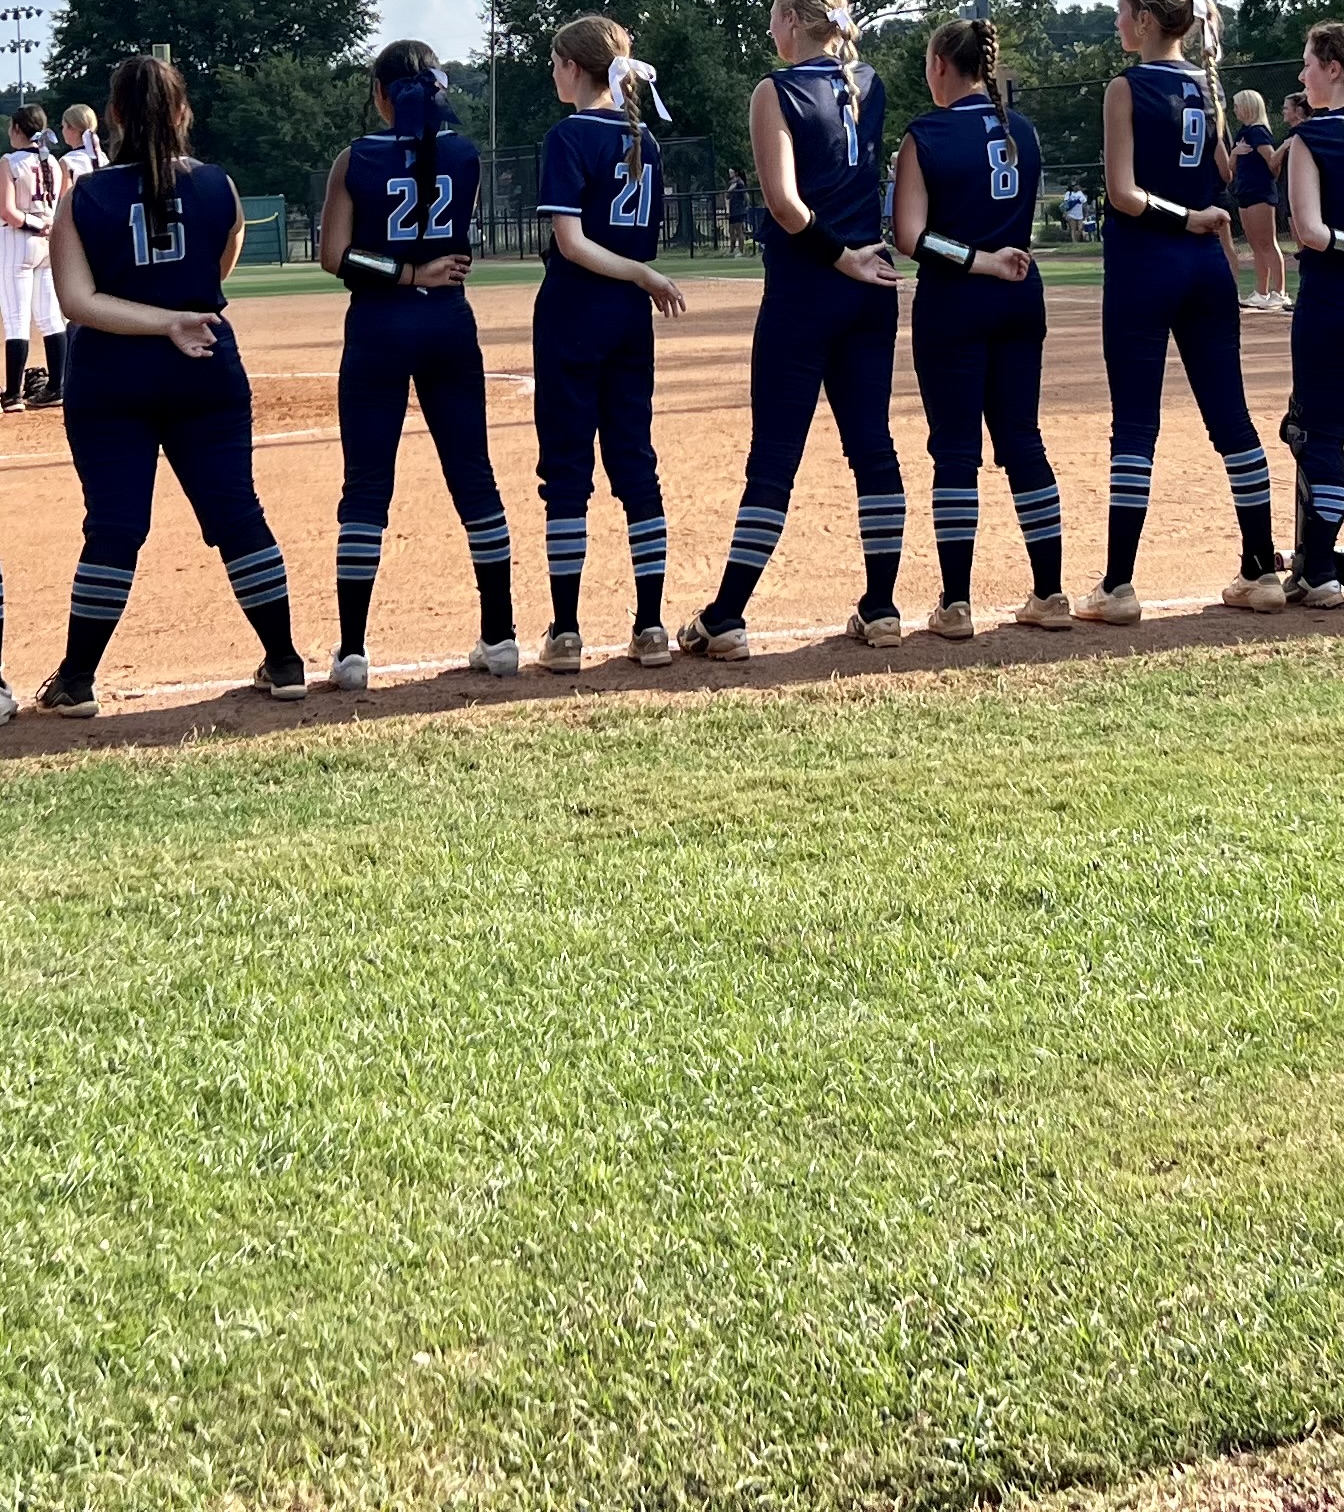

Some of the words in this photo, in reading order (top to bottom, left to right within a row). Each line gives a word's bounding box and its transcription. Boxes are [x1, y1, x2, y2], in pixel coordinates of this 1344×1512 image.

[843, 104, 859, 166] 1
[1179, 108, 1206, 167] 9
[609, 162, 652, 227] 21
[987, 139, 1019, 200] 8
[129, 197, 186, 266] 15
[386, 174, 453, 241] 22
